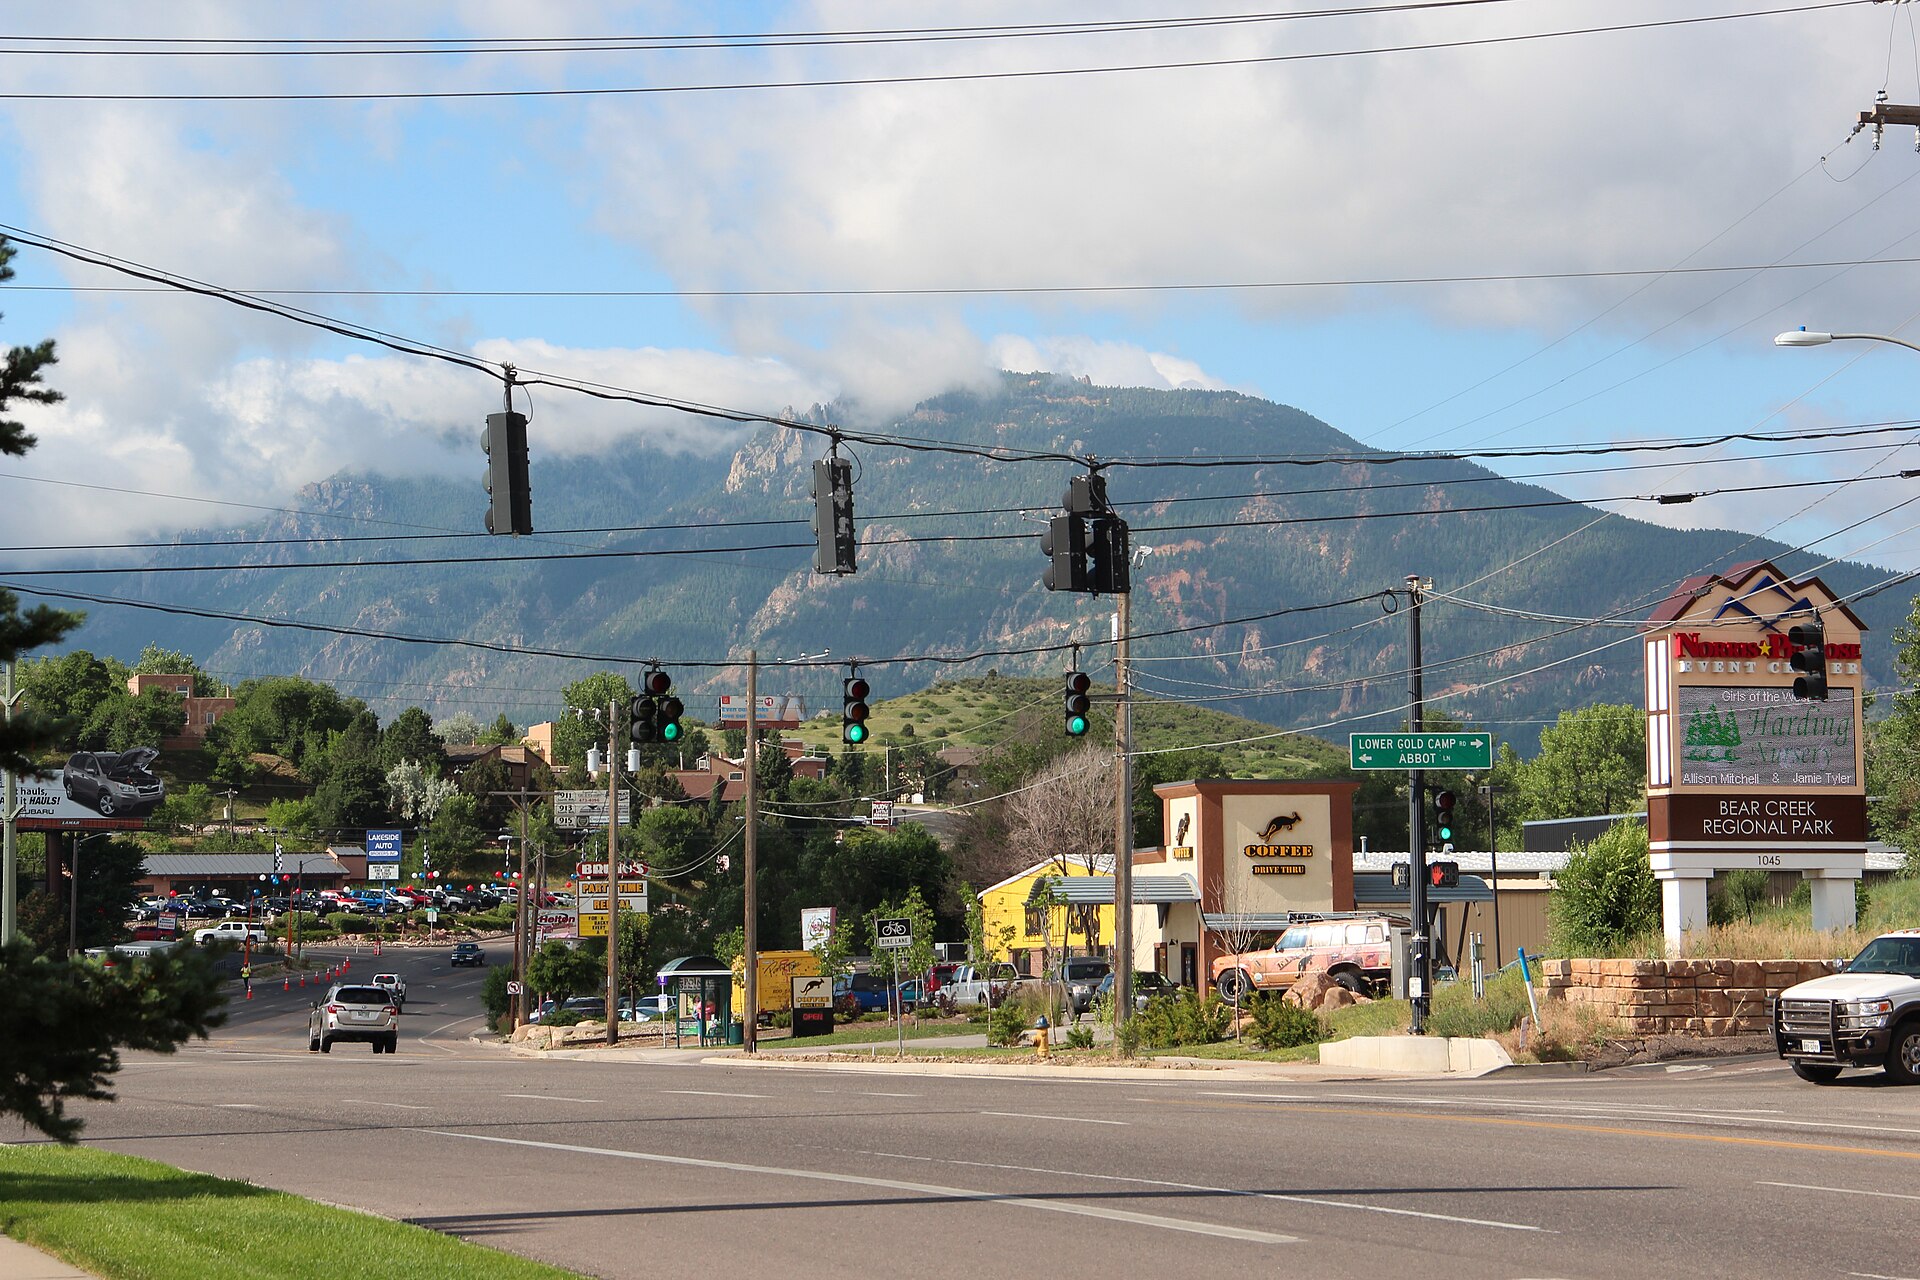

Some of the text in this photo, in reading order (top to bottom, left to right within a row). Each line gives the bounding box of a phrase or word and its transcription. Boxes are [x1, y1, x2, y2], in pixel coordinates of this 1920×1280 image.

[1674, 633, 1861, 659] NORRIS POSE
[1679, 661, 1859, 674] EVENT CEER
[1722, 691, 1747, 702] Girls
[1750, 691, 1760, 702] of
[1762, 691, 1779, 702] the
[1747, 706, 1850, 746] Harding
[1359, 739, 1393, 749] LOWER
[1398, 739, 1423, 749] GOLD
[1428, 739, 1455, 749] CAMP
[1399, 753, 1436, 763] ABBOT
[1750, 742, 1832, 770] Nursery
[1683, 773, 1852, 786] Allison Mitchell & Jamie Tyler
[21, 787, 47, 796] hauls,
[1720, 801, 1816, 816] BEAR CREEK
[1704, 820, 1834, 834] REGIONAL PARK
[1173, 848, 1190, 858] COFFEE
[1245, 846, 1313, 856] COFFEE
[1758, 856, 1781, 865] 1045
[1254, 866, 1280, 874] DRIVE
[620, 883, 644, 893] TIME
[593, 900, 632, 910] REAL
